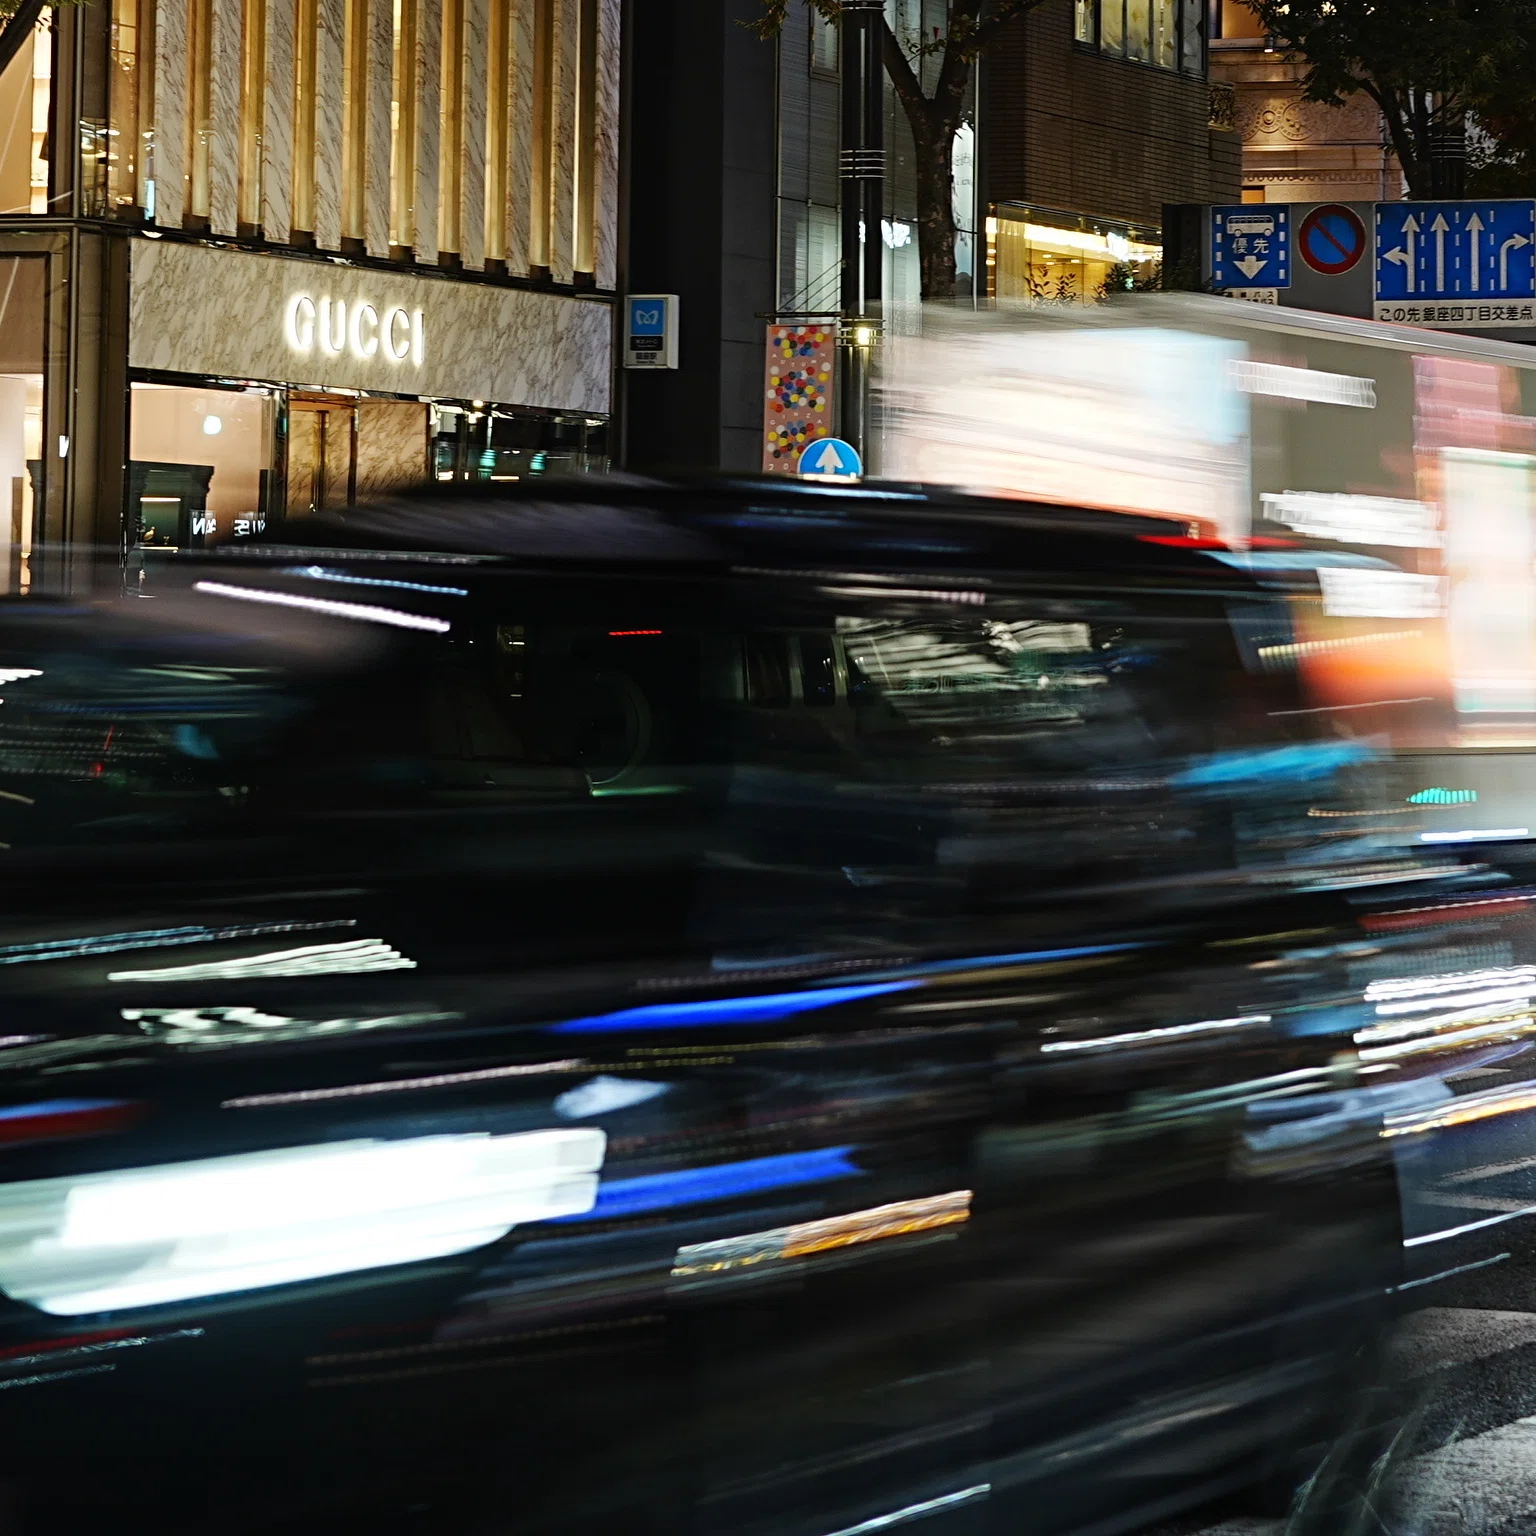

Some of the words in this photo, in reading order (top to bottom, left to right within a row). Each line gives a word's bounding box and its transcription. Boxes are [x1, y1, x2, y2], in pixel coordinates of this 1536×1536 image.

[1232, 238, 1270, 254] 優先
[285, 295, 426, 366] GUCCI
[768, 463, 789, 471] 20
